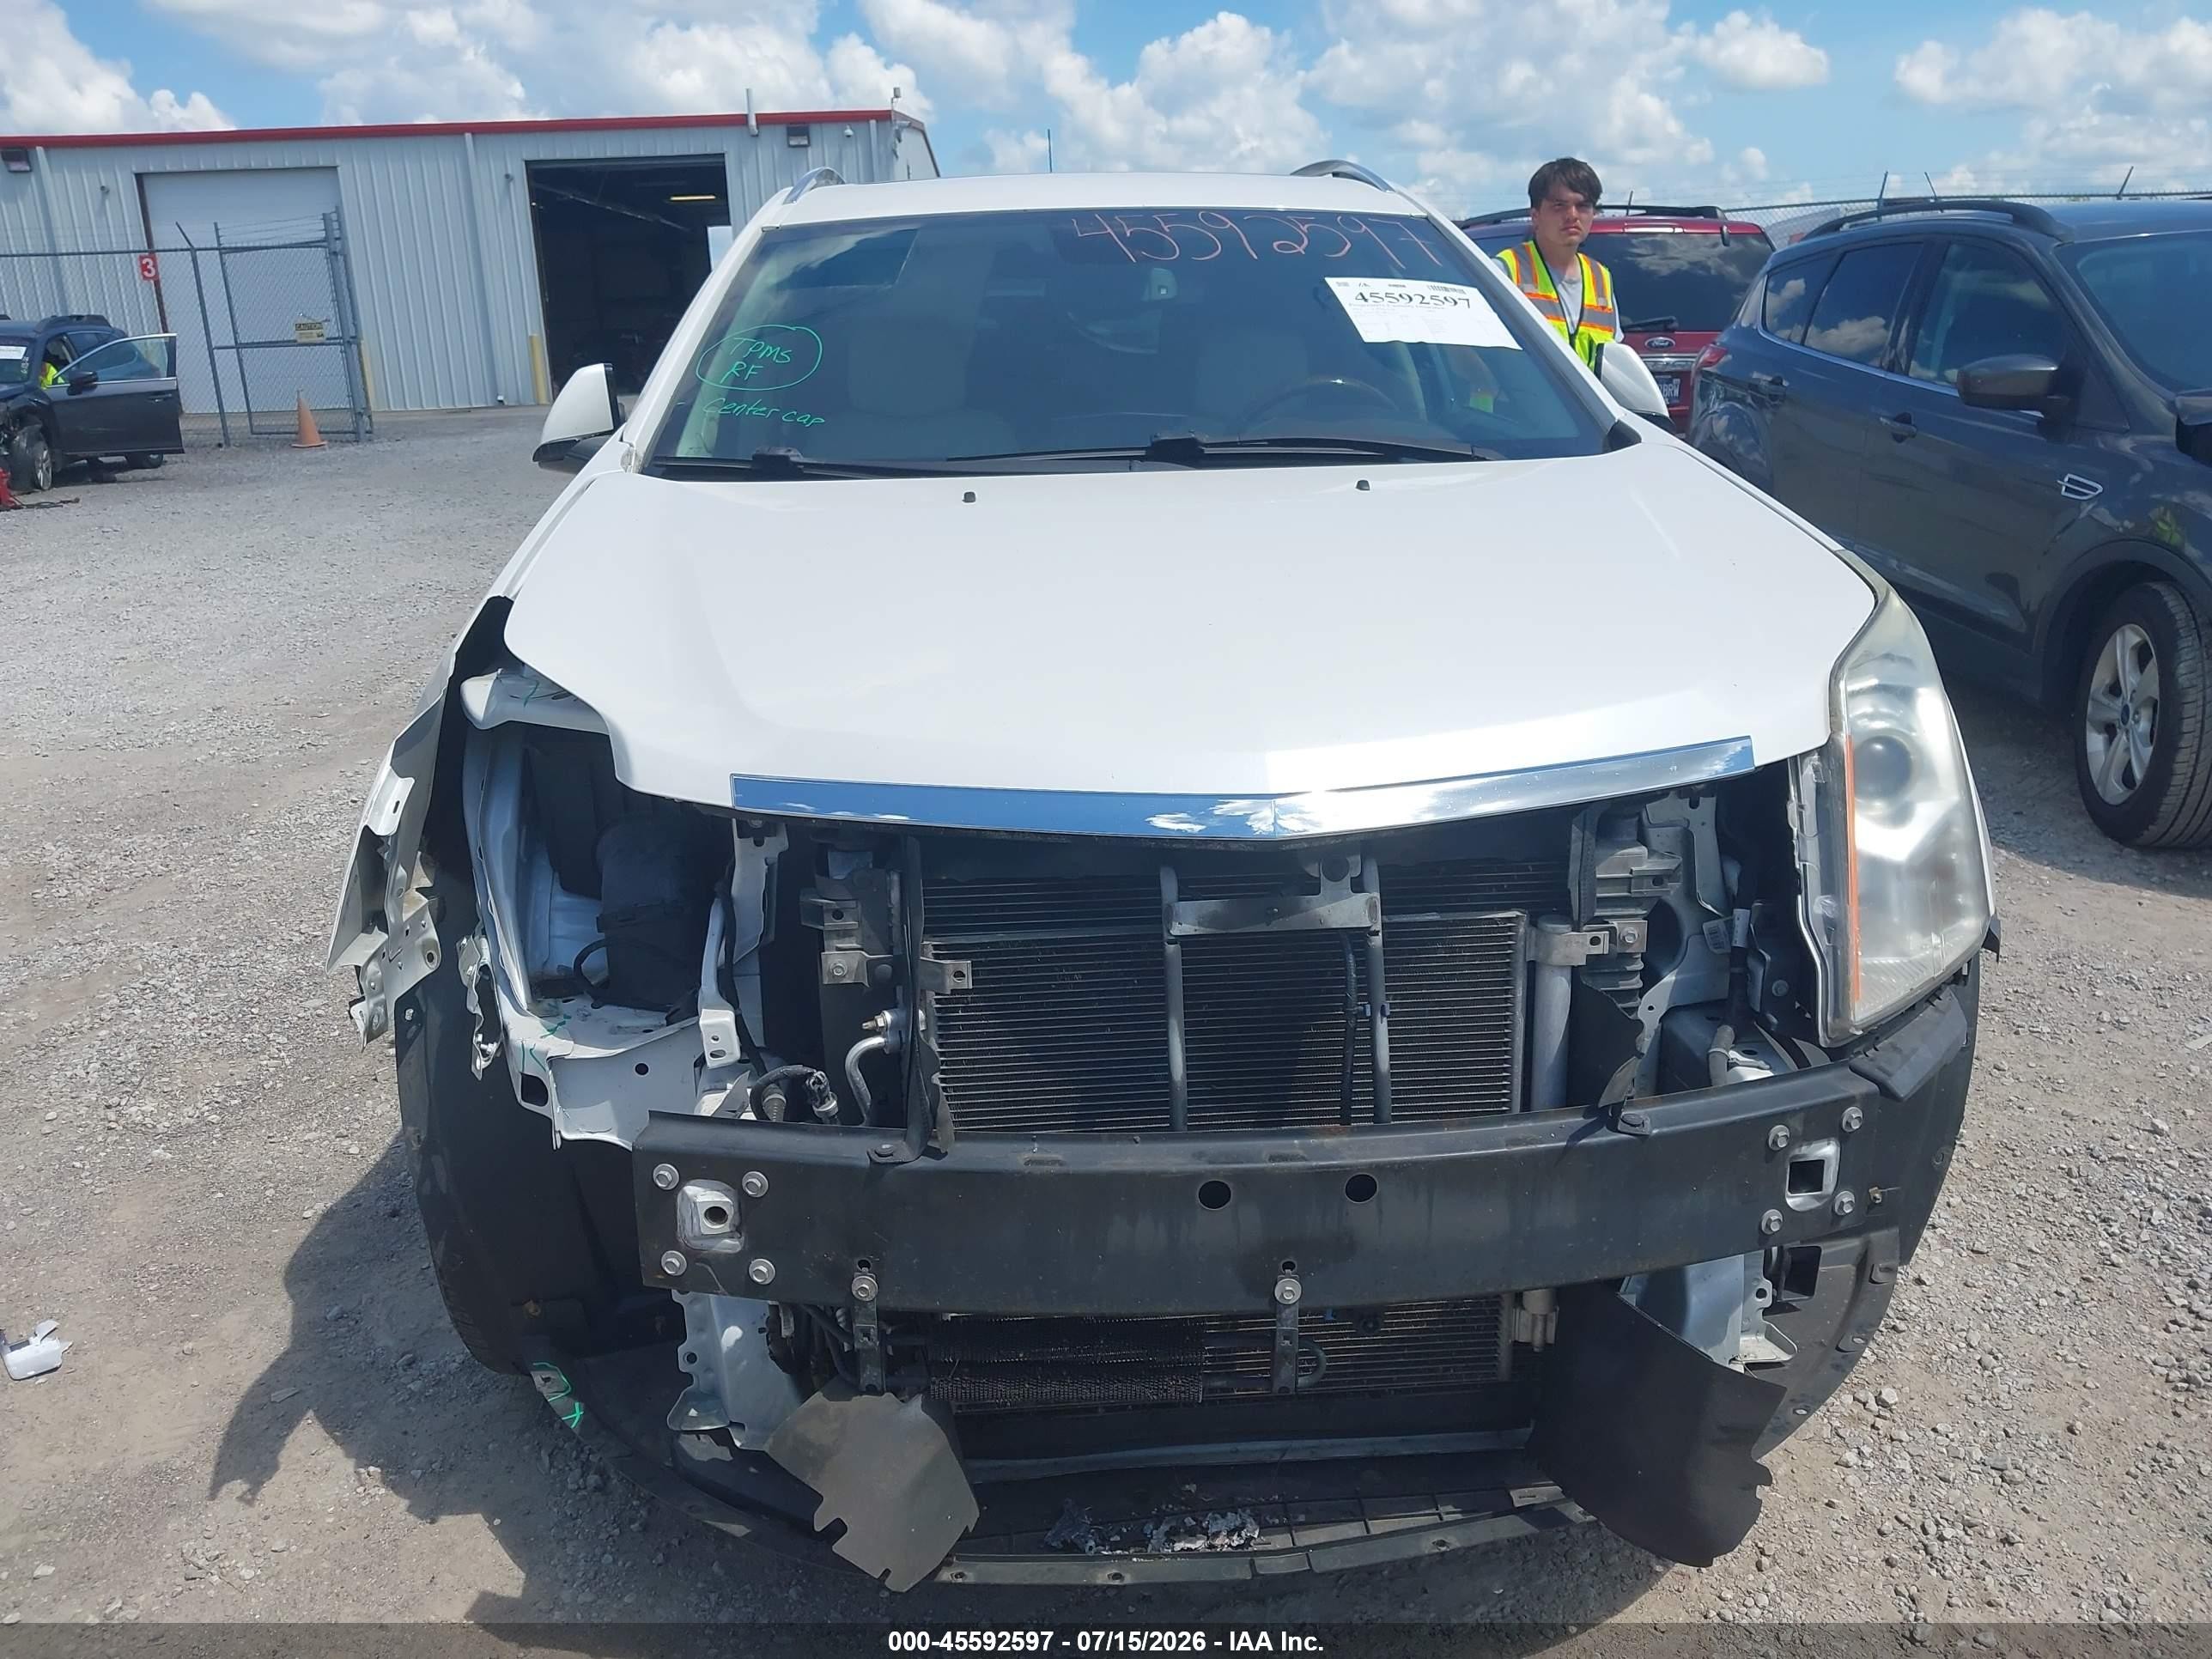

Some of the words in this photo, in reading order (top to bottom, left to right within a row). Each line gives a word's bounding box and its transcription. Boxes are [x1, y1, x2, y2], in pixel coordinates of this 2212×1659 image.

[1072, 211, 1443, 269] 45592597
[143, 258, 156, 278] 3
[1354, 291, 1471, 309] 45592597
[728, 337, 793, 363] TPMS
[720, 362, 764, 384] RF
